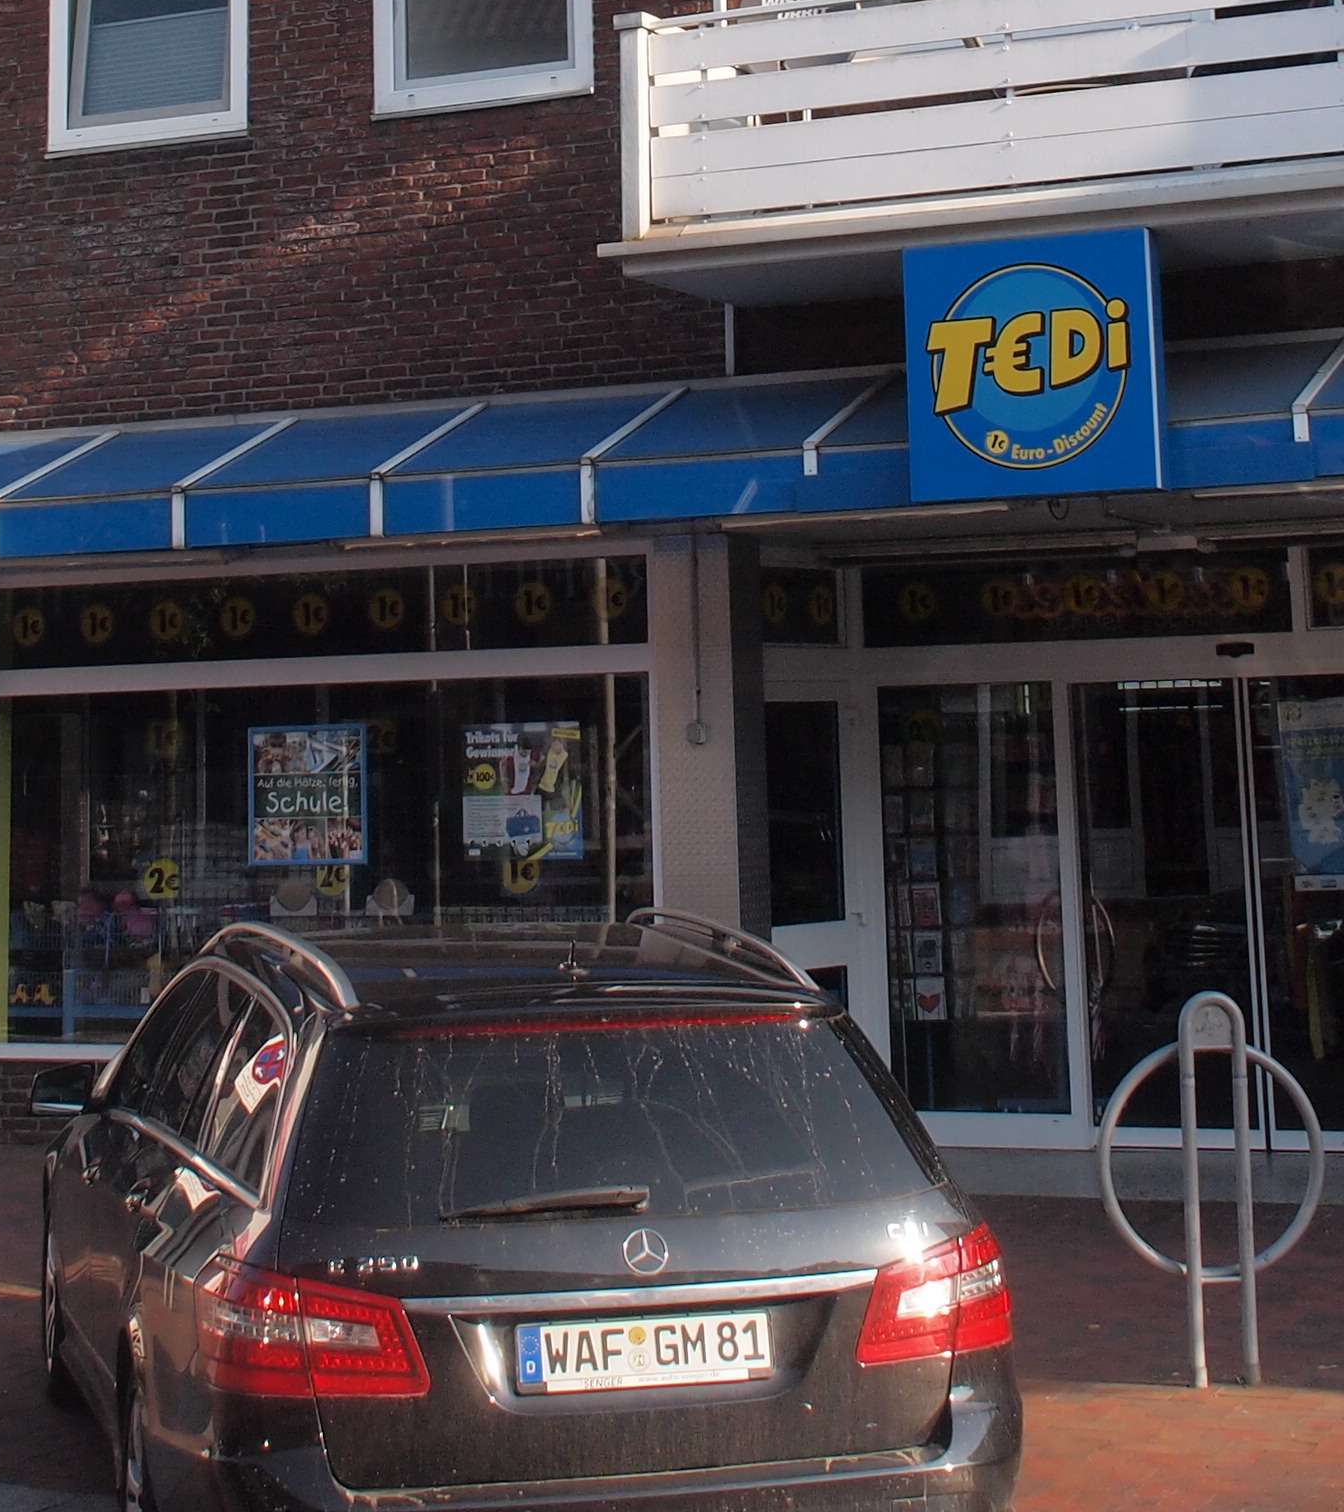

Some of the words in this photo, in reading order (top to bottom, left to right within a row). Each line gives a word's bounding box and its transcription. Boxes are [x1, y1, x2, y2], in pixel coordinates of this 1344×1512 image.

[257, 778, 274, 789] Auf
[276, 777, 292, 788] die
[149, 868, 179, 893] 2€
[544, 1328, 625, 1374] WAF
[653, 1322, 707, 1366] GM
[716, 1319, 765, 1362] 81
[525, 1361, 536, 1373] D
